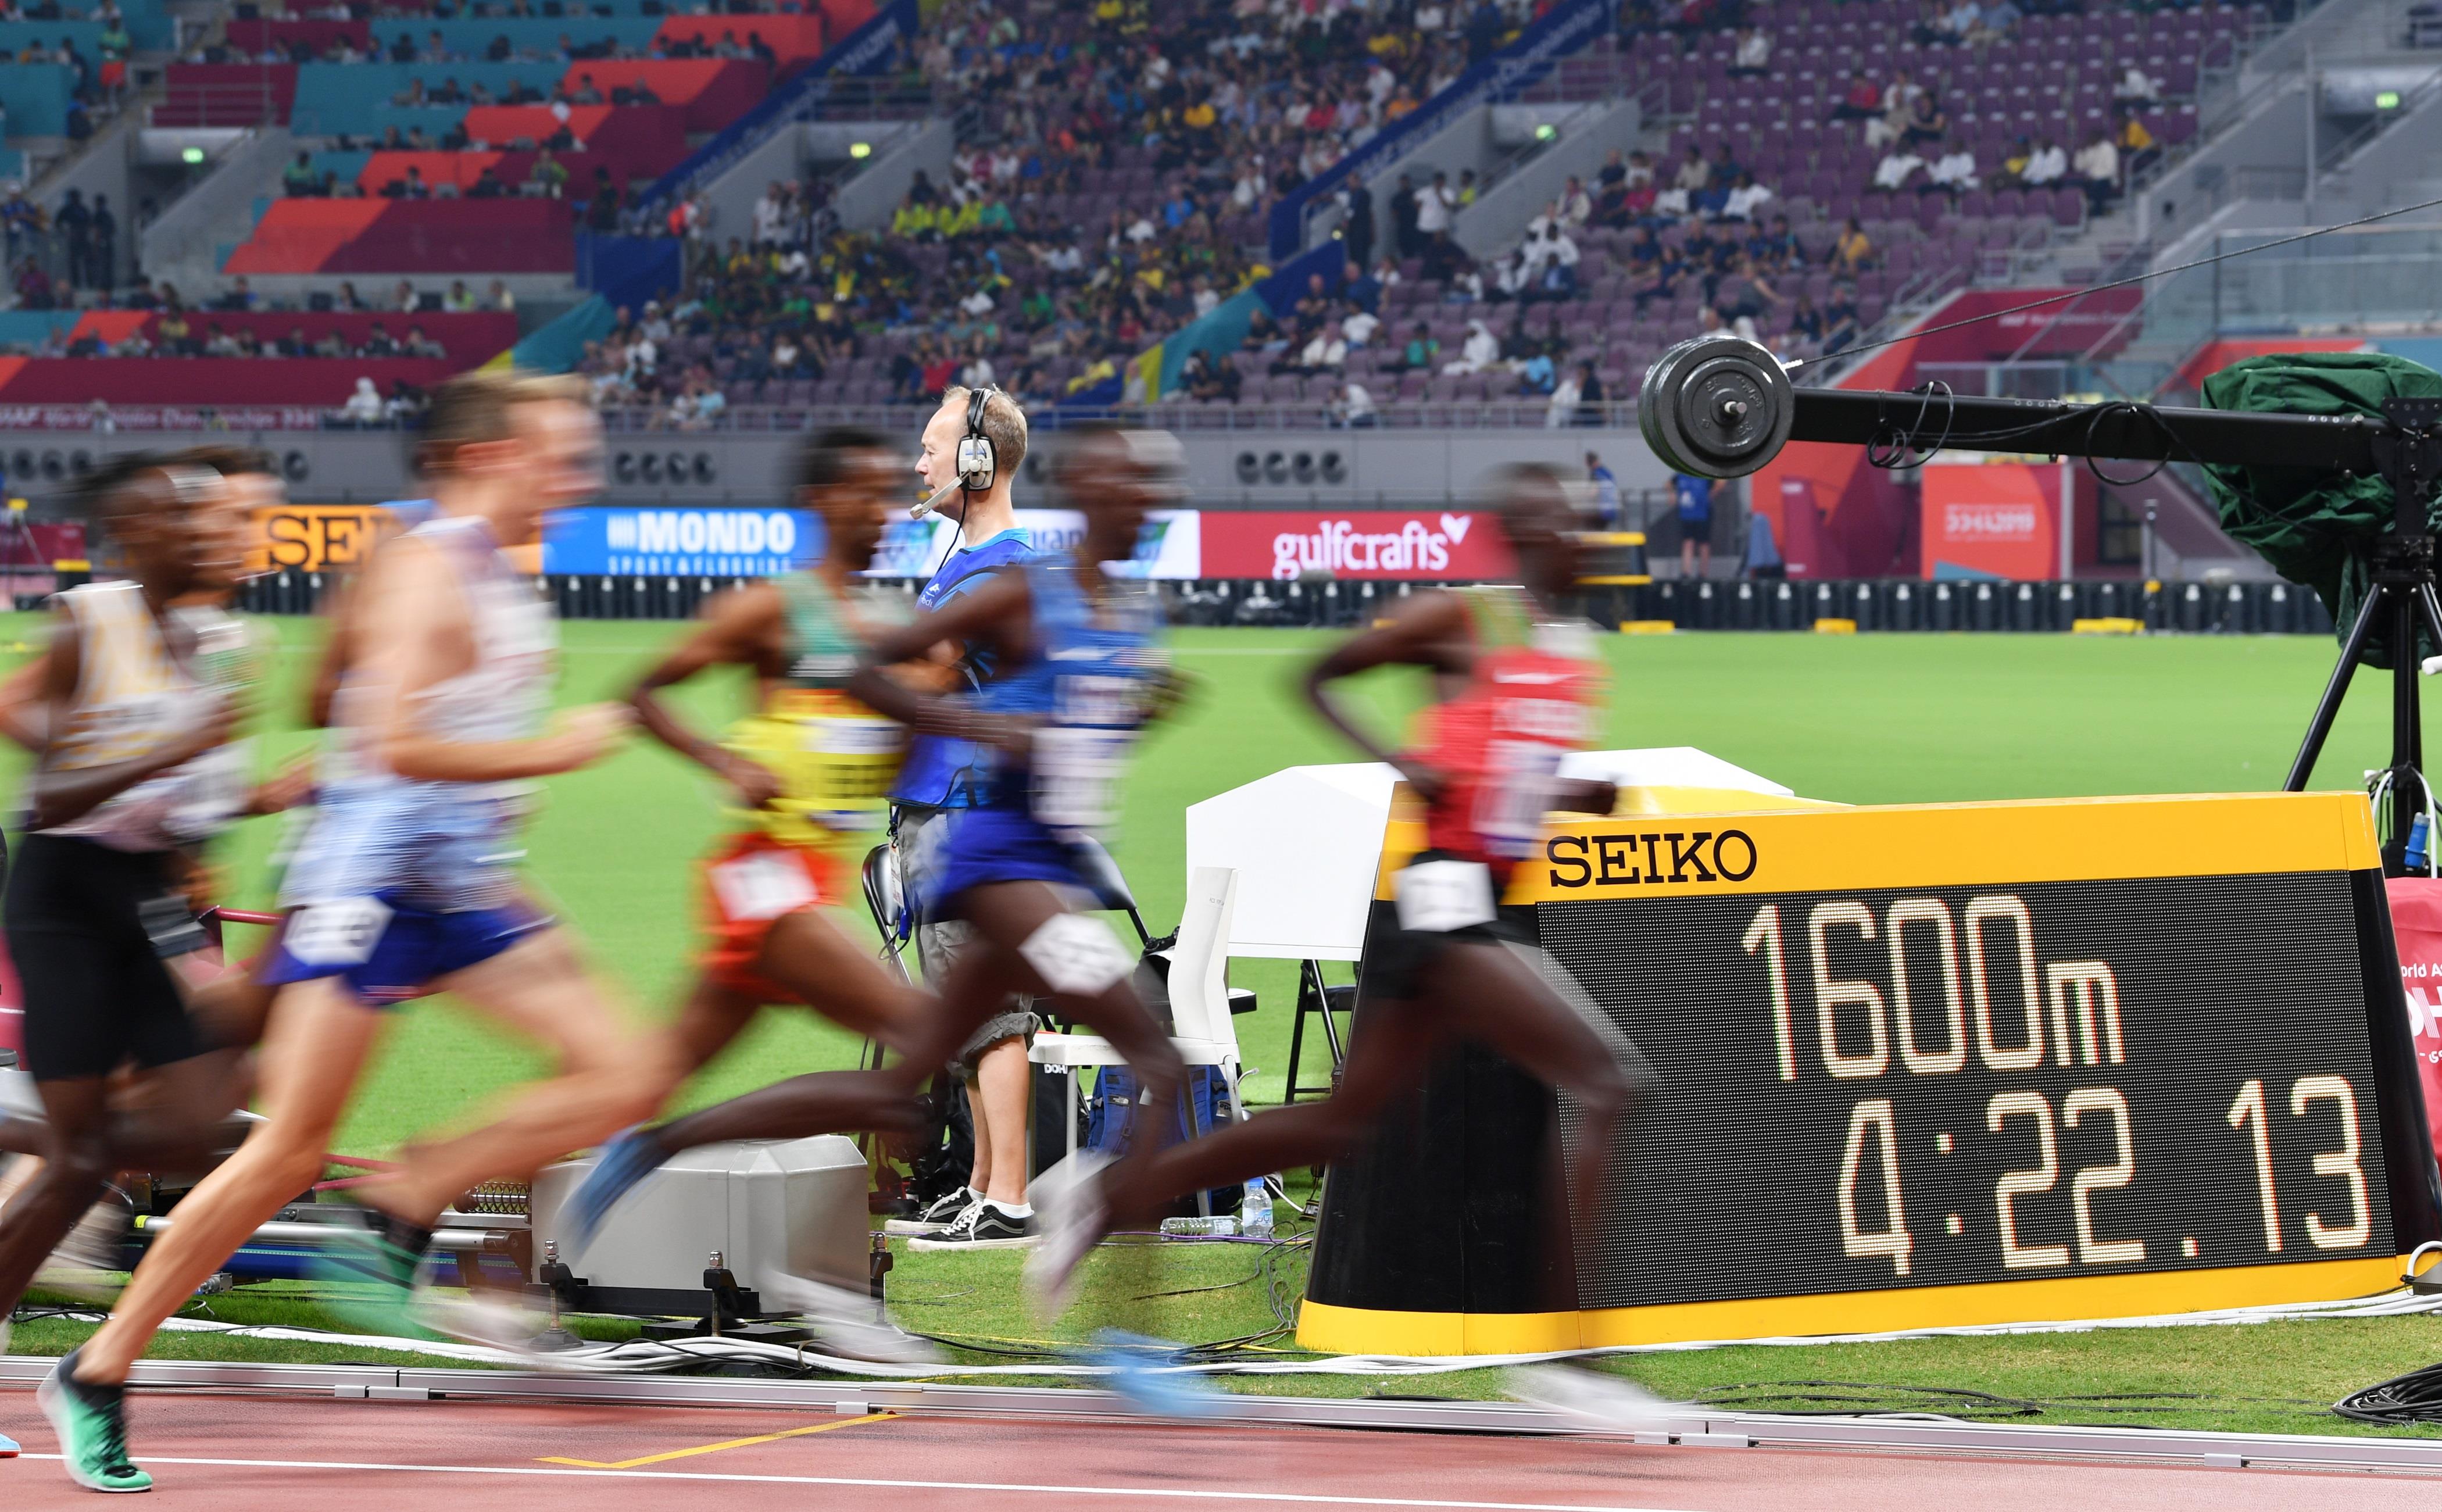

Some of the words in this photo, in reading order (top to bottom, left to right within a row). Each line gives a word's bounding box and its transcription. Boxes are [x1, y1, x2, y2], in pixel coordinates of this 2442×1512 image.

[638, 511, 795, 554] MONDO
[1272, 520, 1449, 580] gulfcrafts
[1546, 829, 1757, 888] SEIKO
[1740, 895, 2125, 1082] 1600m
[2401, 963, 2427, 978] orld
[1044, 1064, 1068, 1074] DOH
